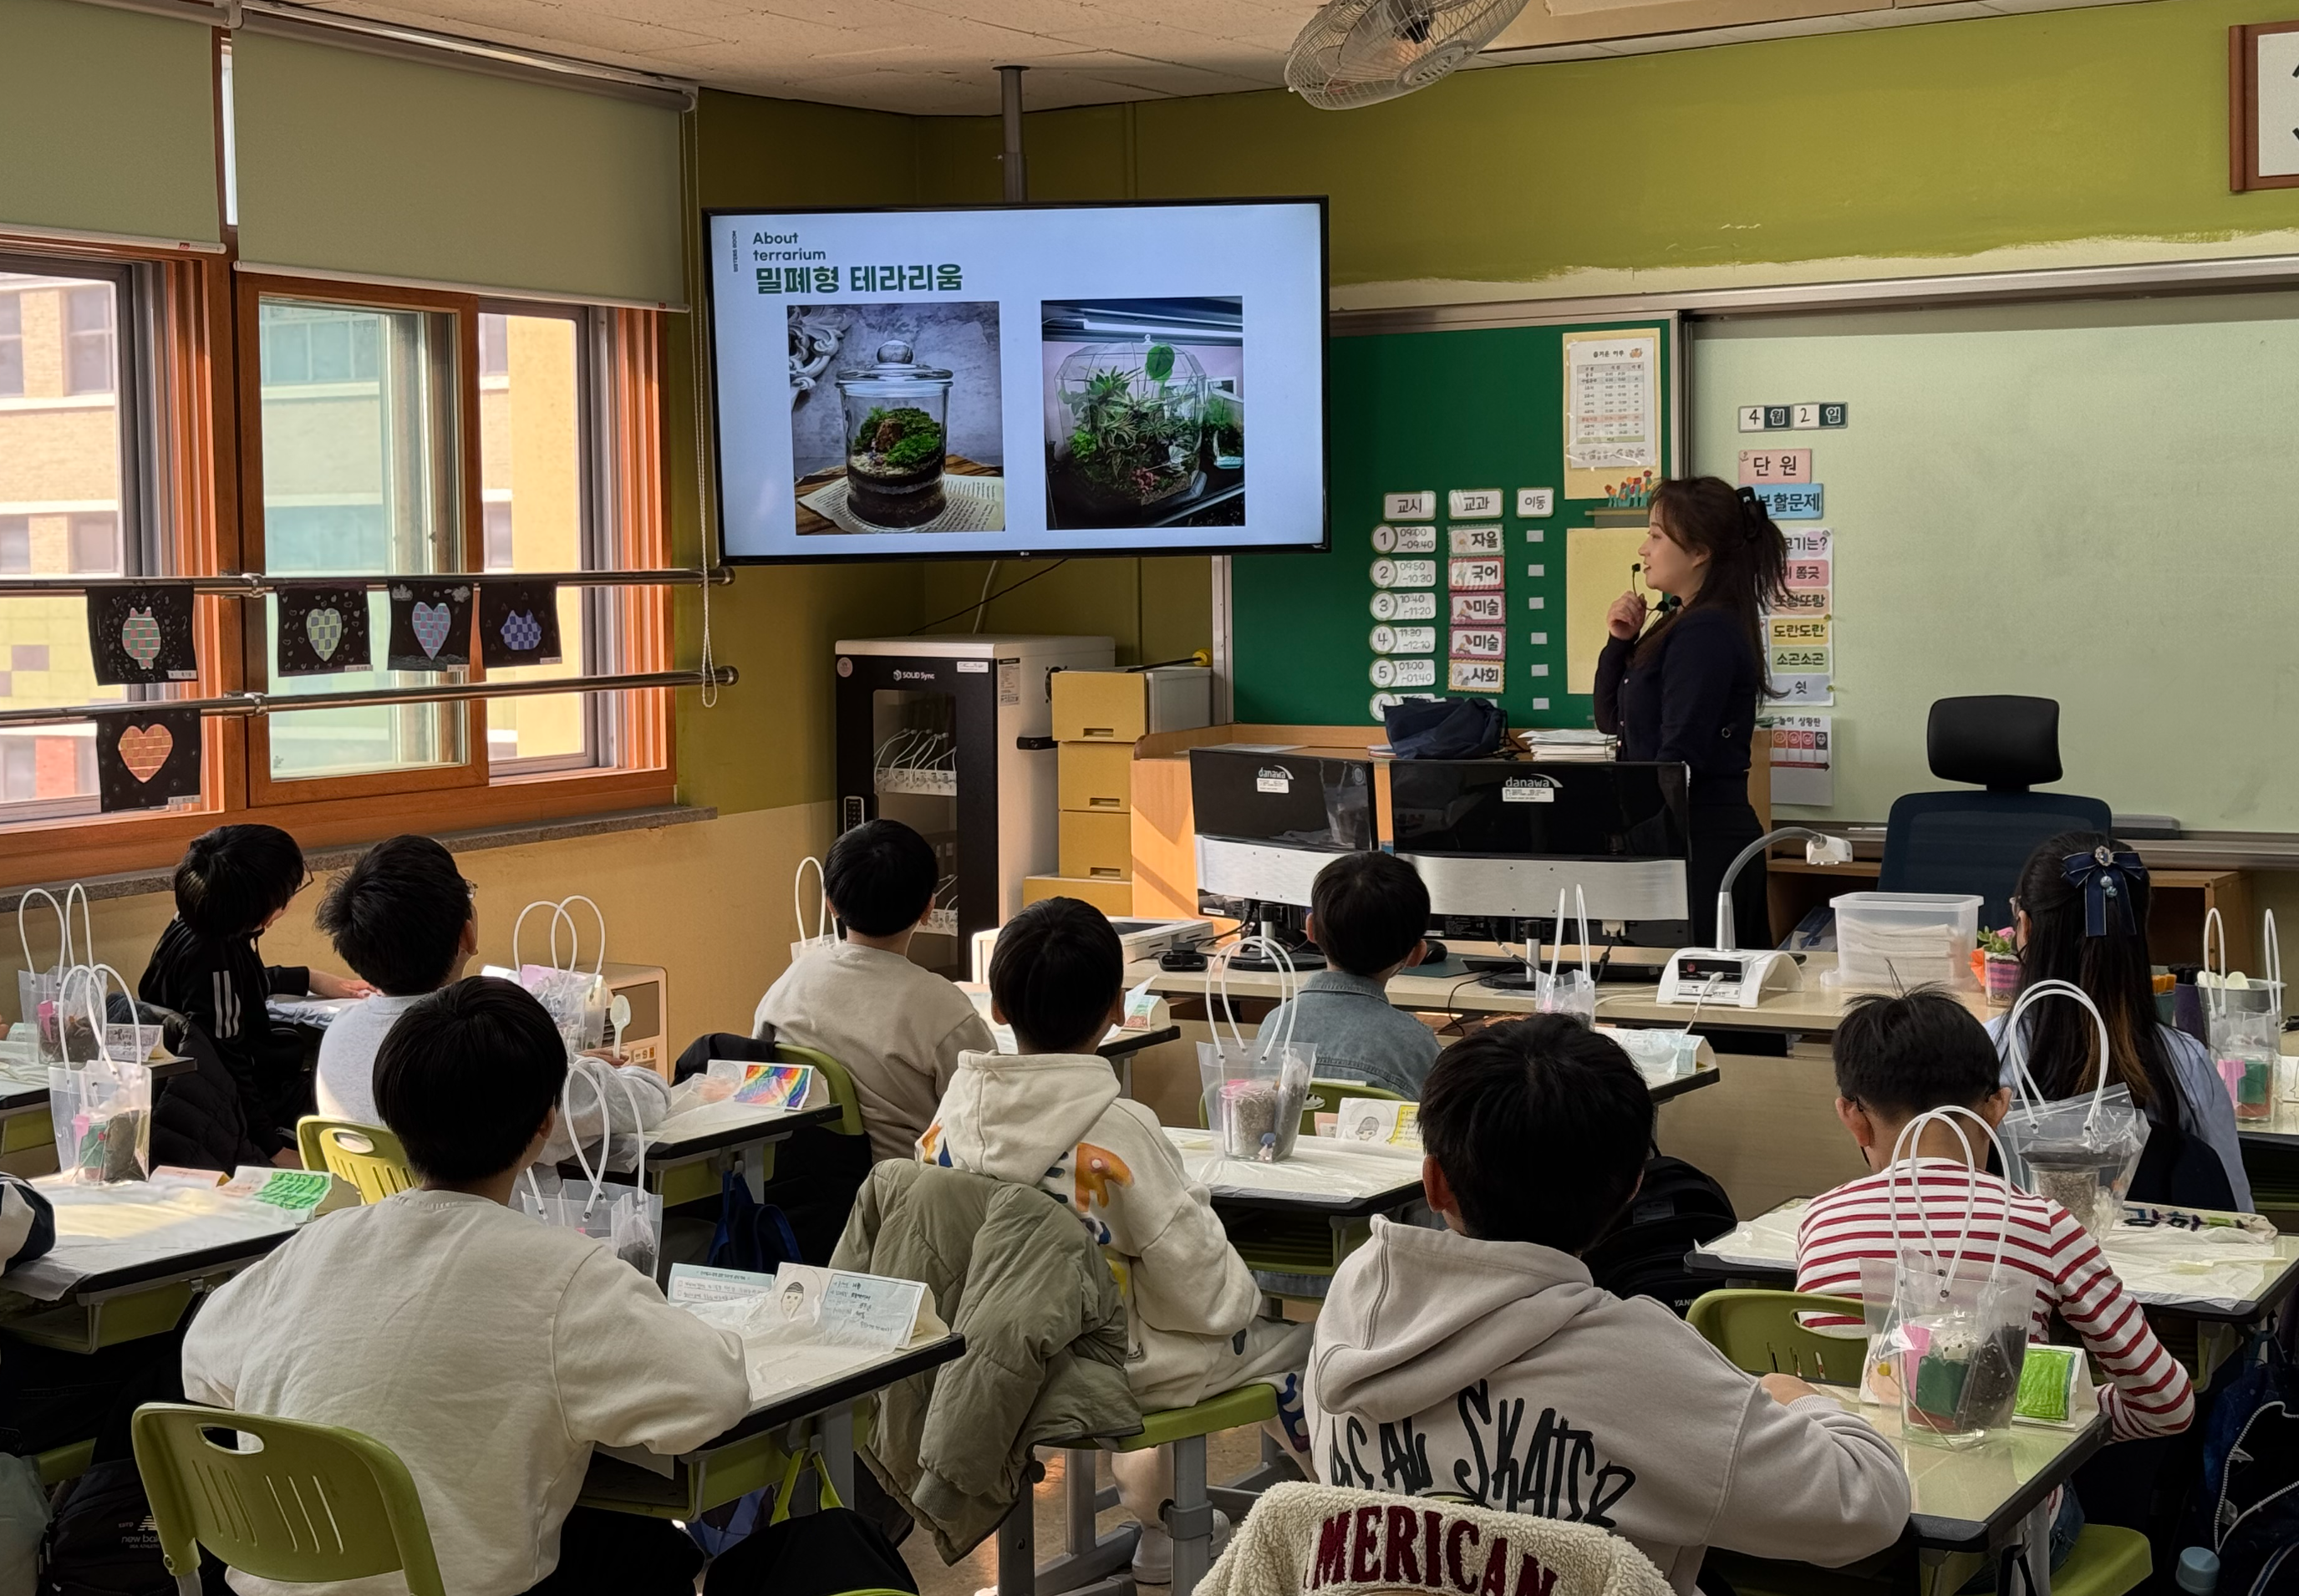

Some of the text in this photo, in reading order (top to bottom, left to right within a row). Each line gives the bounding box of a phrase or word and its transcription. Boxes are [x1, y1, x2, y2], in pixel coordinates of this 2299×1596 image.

[752, 231, 799, 245] About
[752, 247, 827, 262] terrarium
[755, 263, 964, 295] 밀폐형 테라리움
[1396, 499, 1422, 515] 교시
[1463, 496, 1490, 511] 교과
[1524, 495, 1546, 511] 이동
[1380, 532, 1387, 546] 1
[1471, 532, 1498, 548] 자율
[1379, 566, 1388, 579] 2
[1472, 565, 1498, 581] 국어
[1796, 566, 1820, 580] 쫑긋
[1379, 599, 1388, 612] 3
[1473, 599, 1499, 616] 미술
[1377, 632, 1388, 644] 4
[1773, 624, 1825, 638] 도란도란
[1473, 634, 1499, 651] 미술
[1776, 653, 1825, 665] 소곤소곤
[921, 672, 935, 681] Sync
[1379, 666, 1387, 679] 5
[1472, 668, 1498, 684] 사회
[1795, 680, 1807, 694] 쉿
[1258, 766, 1286, 779] danawa
[1505, 775, 1550, 788] danawa
